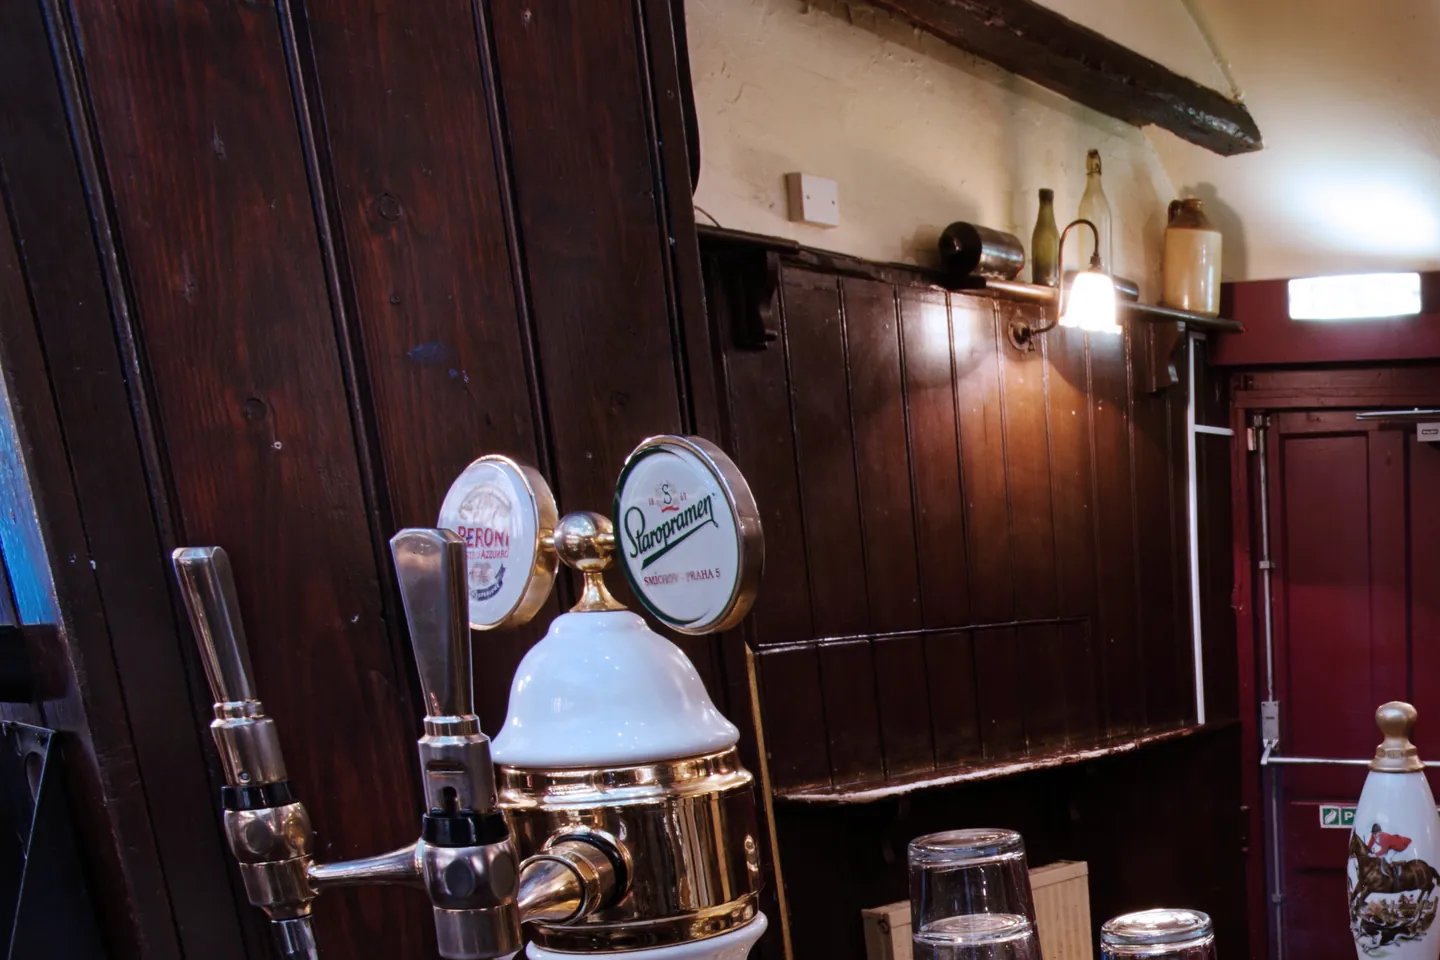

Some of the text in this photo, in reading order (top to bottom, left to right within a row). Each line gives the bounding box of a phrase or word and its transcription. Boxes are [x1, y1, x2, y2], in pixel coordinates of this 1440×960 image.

[458, 525, 510, 549] PERONI
[624, 493, 718, 558] Staropramen
[686, 568, 714, 583] PRAHA
[715, 568, 721, 578] 5
